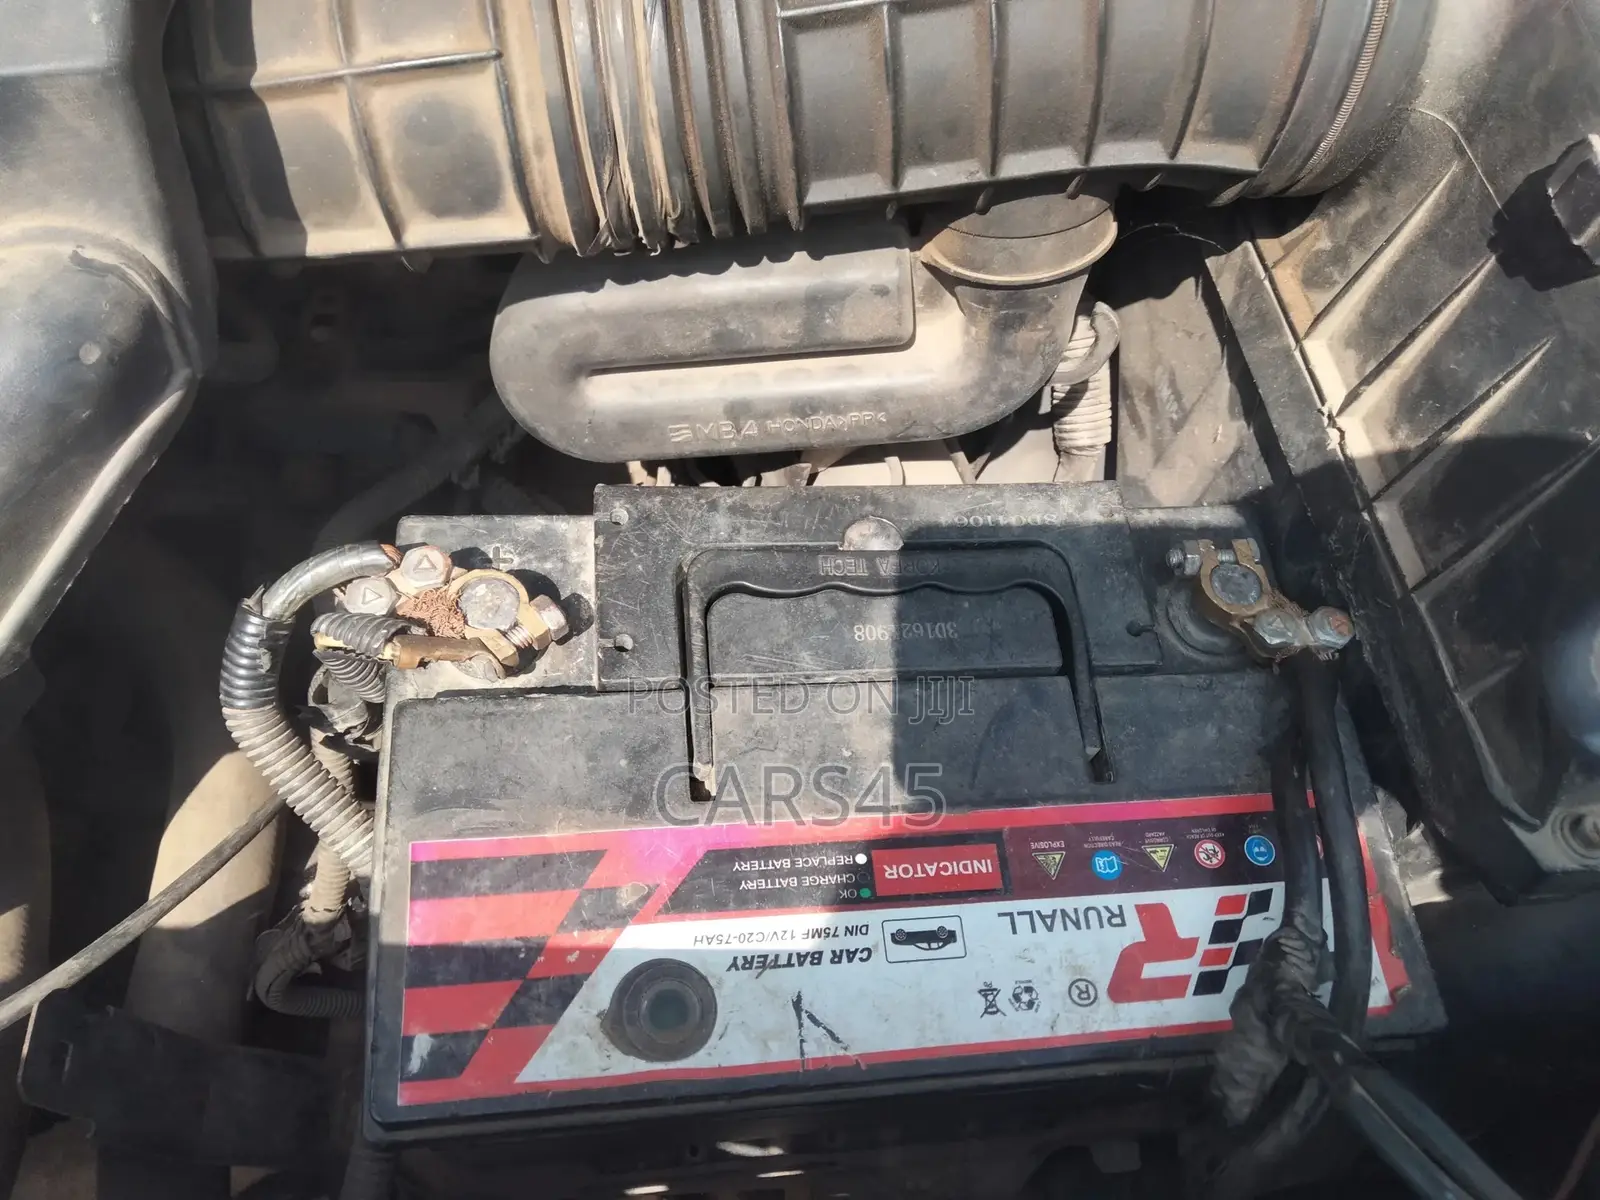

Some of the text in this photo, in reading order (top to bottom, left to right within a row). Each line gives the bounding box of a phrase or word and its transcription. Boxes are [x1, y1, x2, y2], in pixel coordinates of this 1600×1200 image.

[819, 555, 869, 576] TECH
[1030, 840, 1065, 850] EXPLOSIVE
[732, 854, 853, 871] REPLACE BATTERY
[883, 858, 993, 879] INDICATOR
[739, 873, 855, 890] CHARGE BATTERY
[840, 889, 857, 899] OK
[997, 904, 1127, 935] RUNALL
[693, 923, 870, 946] DIN 75MF 12V/C20-75AH
[726, 946, 872, 972] CAR BATTERY
